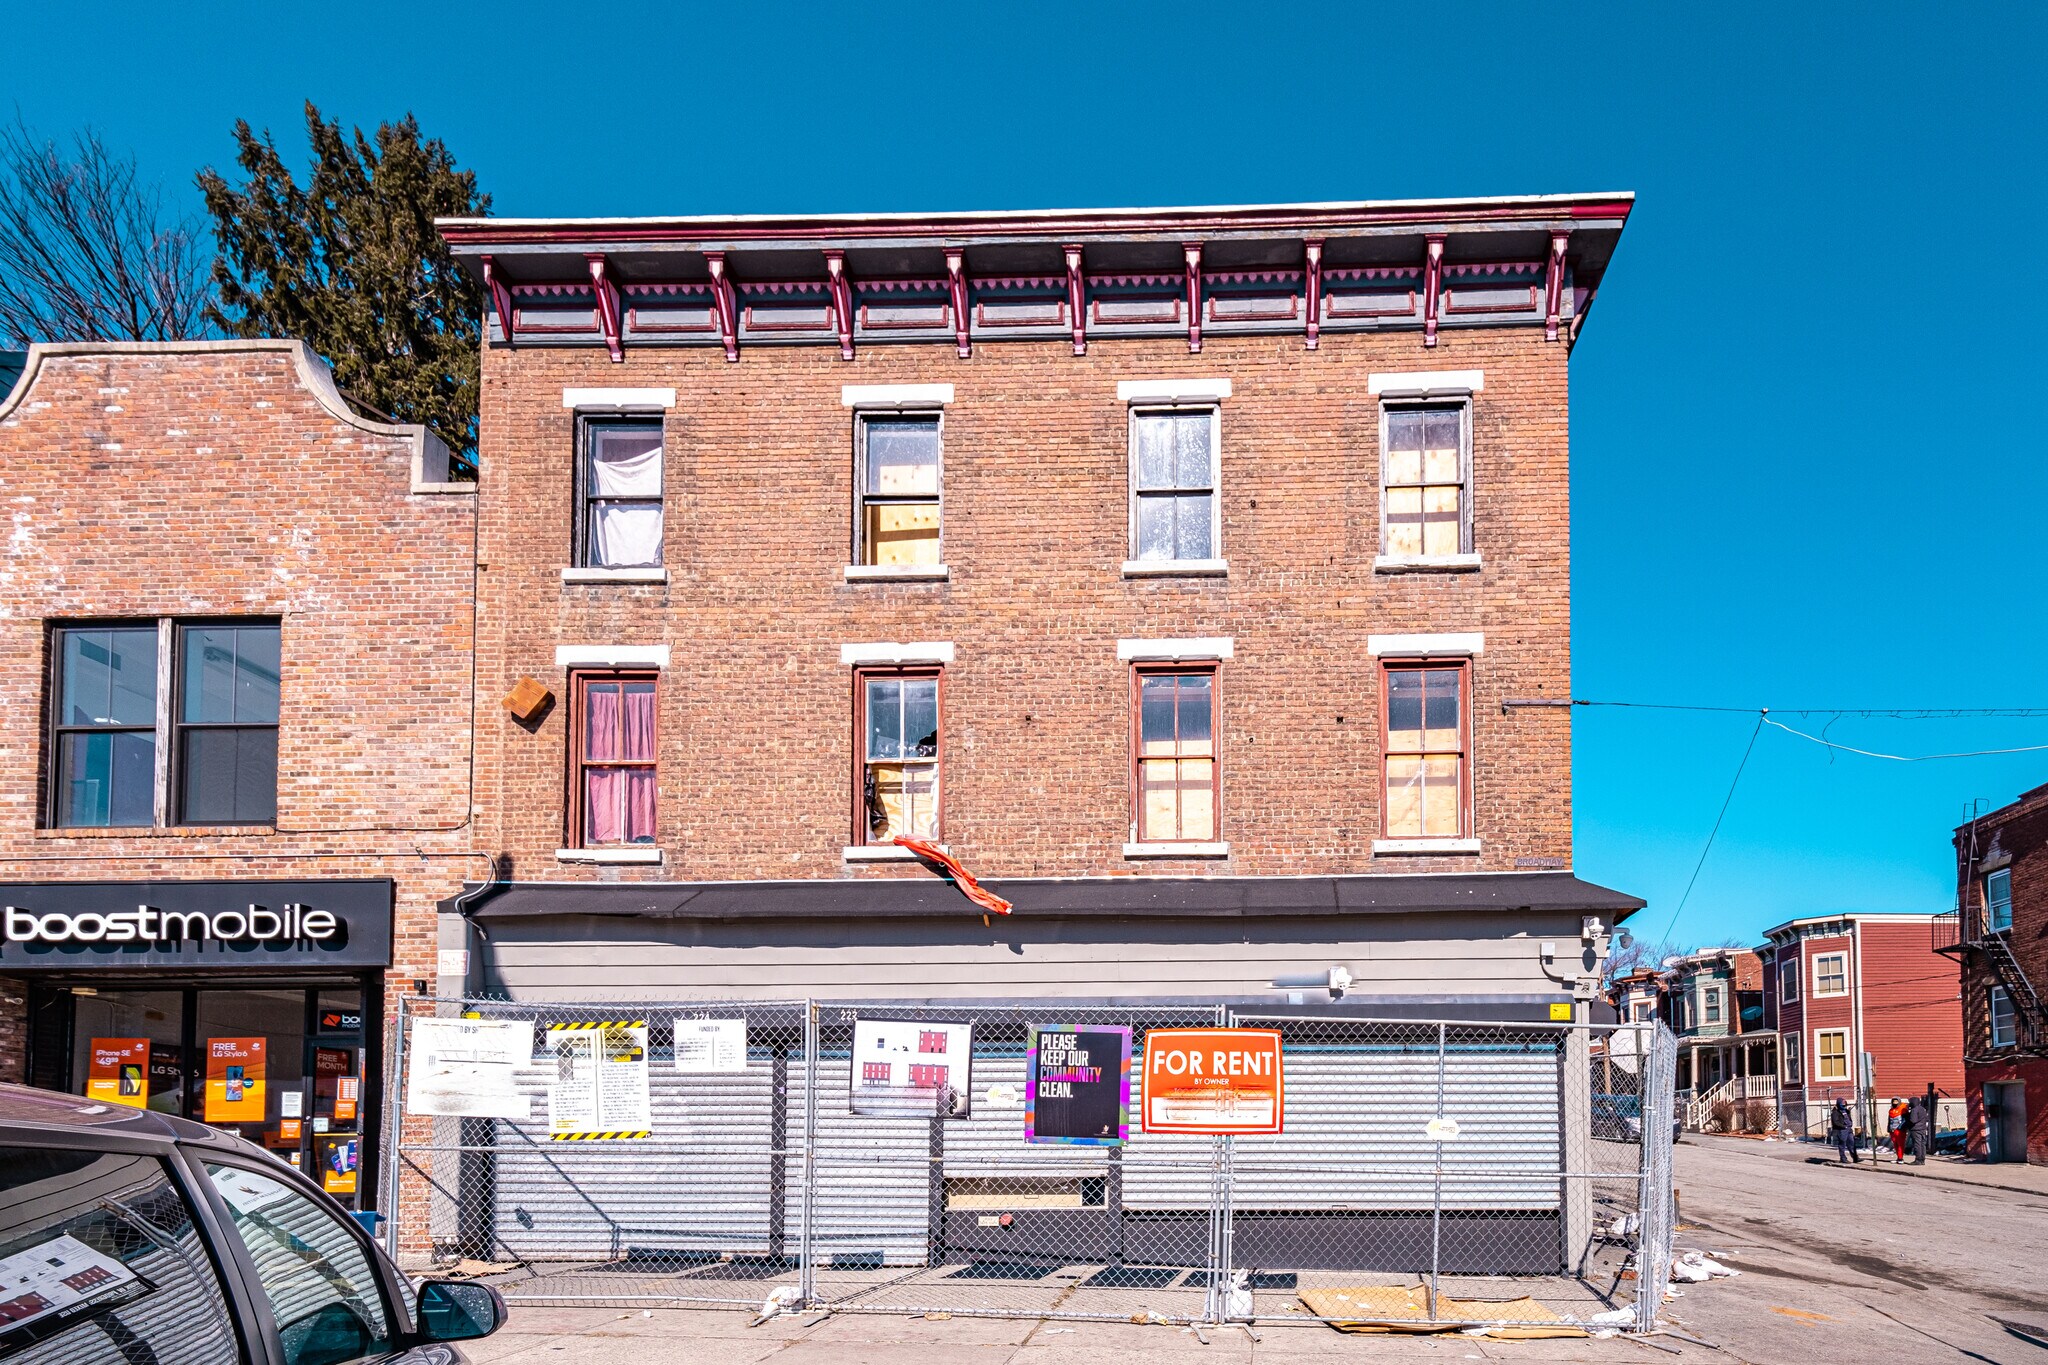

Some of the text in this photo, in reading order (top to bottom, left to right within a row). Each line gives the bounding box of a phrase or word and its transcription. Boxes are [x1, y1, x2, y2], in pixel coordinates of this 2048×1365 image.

[1041, 1034, 1077, 1050] PLEASE
[318, 1053, 337, 1062] FREE
[1040, 1051, 1088, 1066] KEEP OUR
[1153, 1050, 1273, 1075] FOR RENT
[151, 1066, 165, 1074] LG
[317, 1062, 346, 1070] MONTH
[1040, 1066, 1102, 1083] COMMUNITY
[1040, 1082, 1073, 1098] CLEAN.
